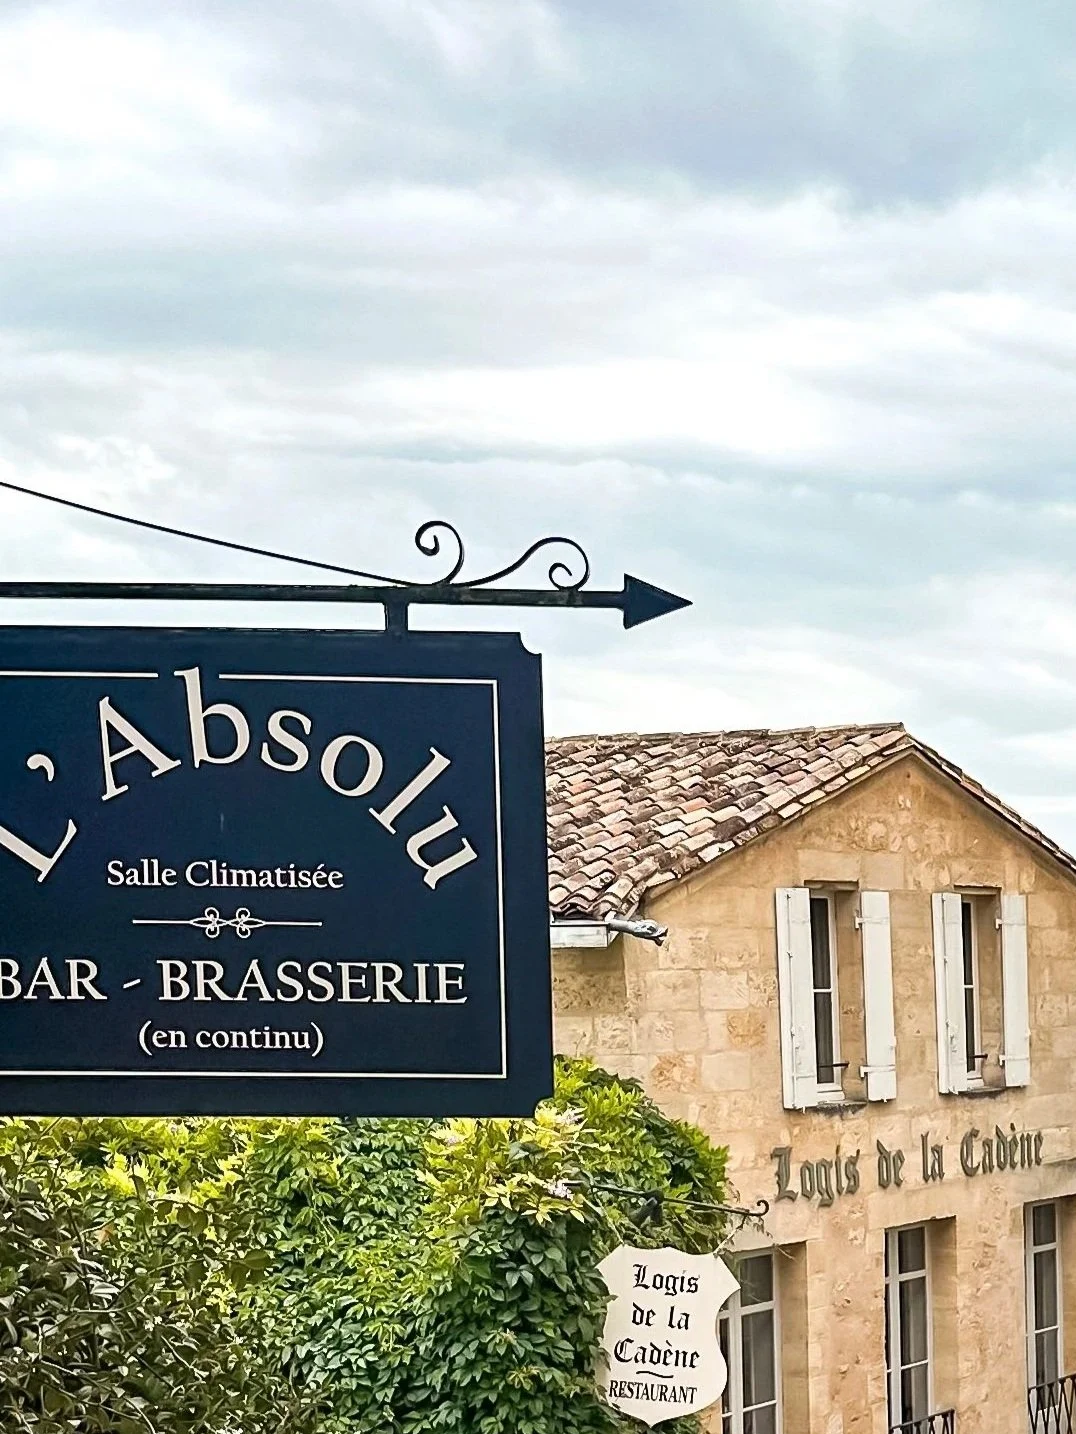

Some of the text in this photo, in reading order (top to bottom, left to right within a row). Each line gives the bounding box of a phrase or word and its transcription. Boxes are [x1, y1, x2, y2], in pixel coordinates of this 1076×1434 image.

[0, 666, 478, 889] L'Absolu
[107, 859, 344, 889] Salle Climatisée
[0, 956, 108, 1000] BAR
[156, 958, 468, 1003] BRASSERIE
[138, 1020, 324, 1057] (en continu)
[770, 1122, 1045, 1207] Logis de la Cadène
[632, 1263, 701, 1297] Logis
[631, 1301, 691, 1330] de la
[613, 1337, 700, 1369] Cadène
[608, 1379, 698, 1405] RESTAURANT
